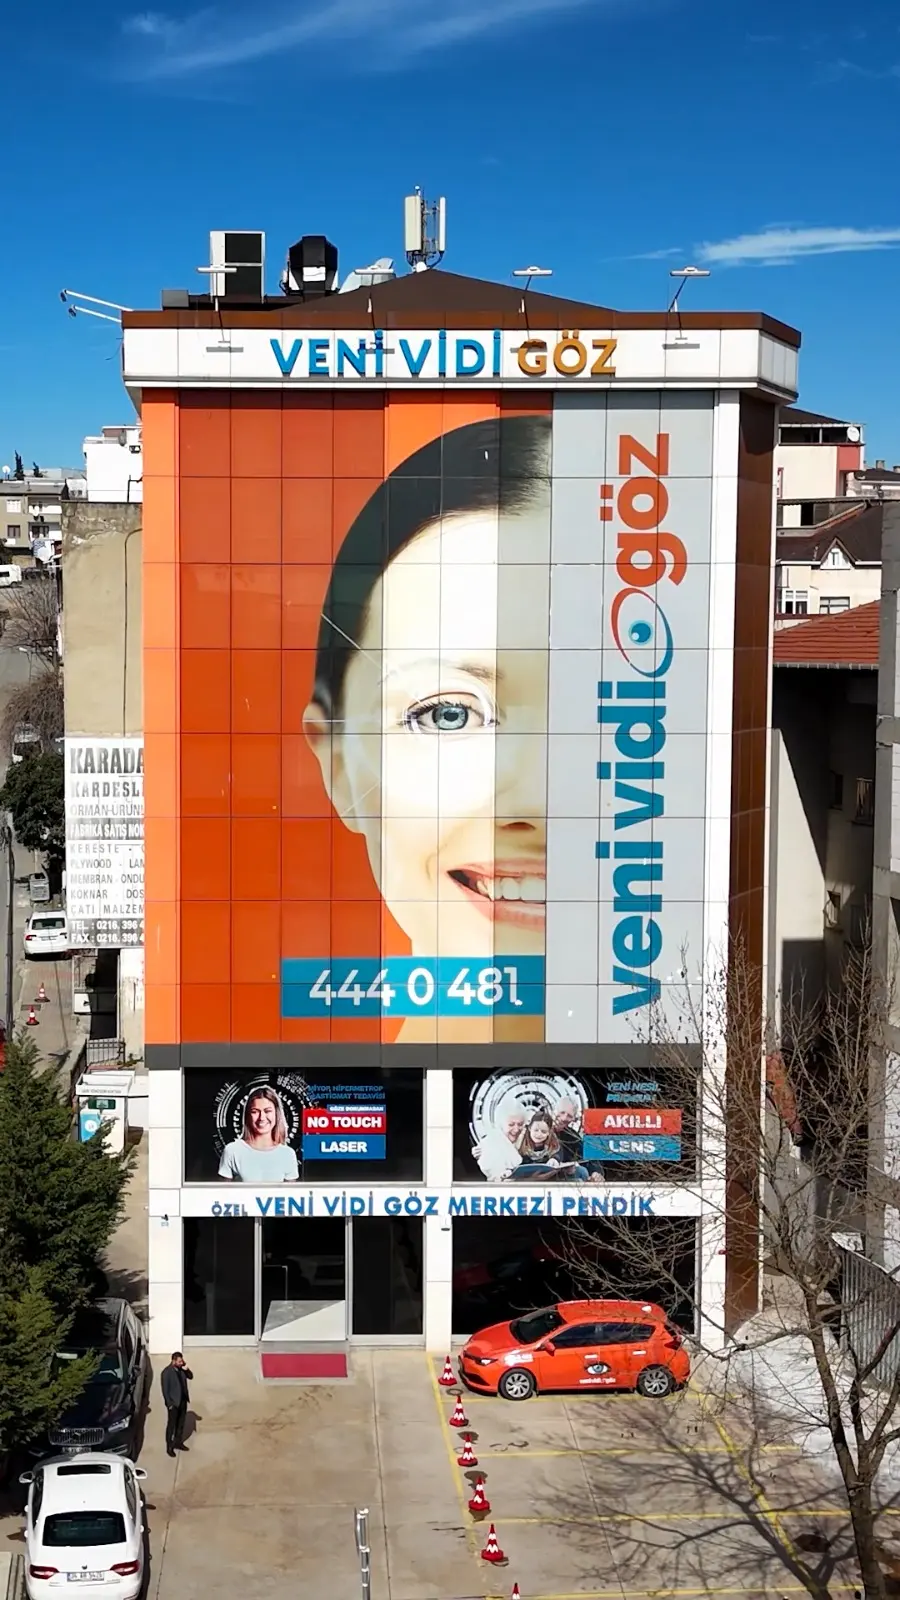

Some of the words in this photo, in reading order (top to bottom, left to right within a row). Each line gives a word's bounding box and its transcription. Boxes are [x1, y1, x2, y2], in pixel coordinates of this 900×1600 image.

[399, 329, 501, 376] VİDİ
[517, 329, 617, 377] GÖZ
[600, 433, 687, 586] göz
[69, 844, 120, 854] KERESTE
[70, 858, 112, 869] PLYWOOD
[70, 873, 113, 884] MEMBRAN
[309, 969, 396, 1006] 444
[407, 967, 434, 1006] 0
[447, 967, 518, 1005] 481
[307, 1116, 329, 1128] NO
[332, 1116, 382, 1129] TOUCH
[604, 1114, 662, 1129] AKILLI
[321, 1141, 368, 1153] LASER
[609, 1140, 656, 1154] LENS
[211, 1201, 248, 1217] ÖZEL
[255, 1191, 314, 1217] VENİ
[322, 1191, 374, 1217] VİDİ
[384, 1191, 439, 1217] GÖZ
[448, 1191, 553, 1217] MERKEZİ
[562, 1191, 655, 1217] PENDİK
